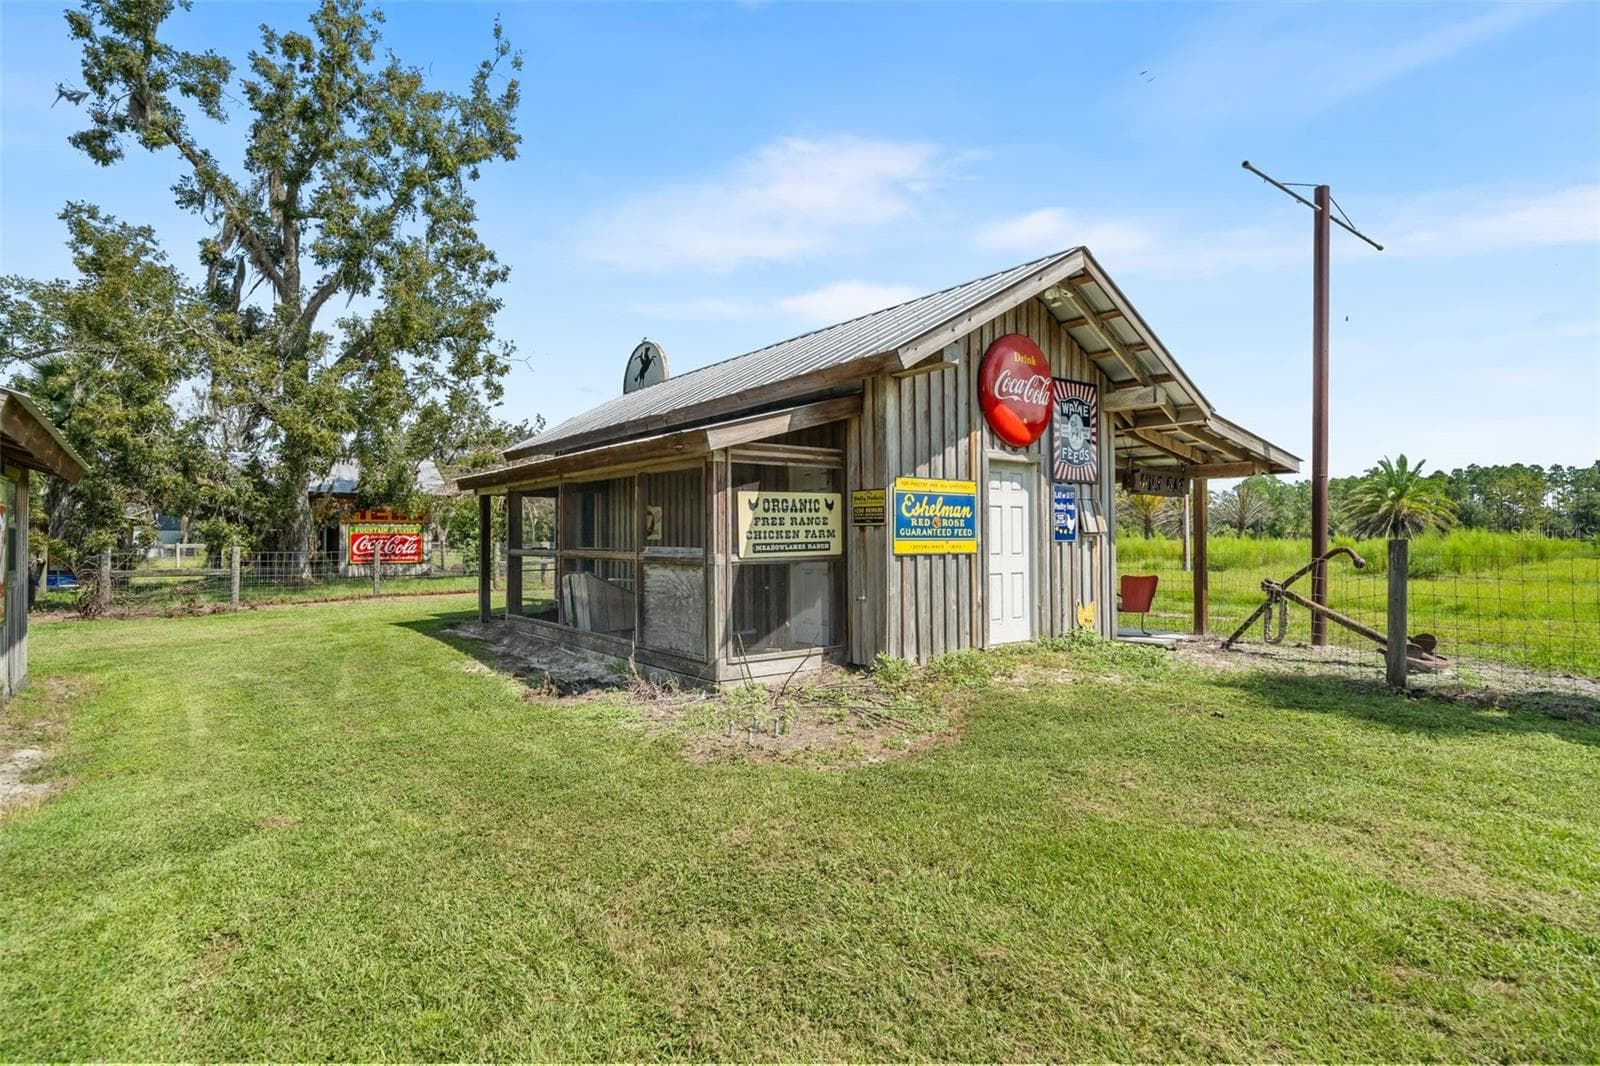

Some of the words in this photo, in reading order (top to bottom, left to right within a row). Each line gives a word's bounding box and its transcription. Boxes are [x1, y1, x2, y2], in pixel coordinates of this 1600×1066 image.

[1014, 351, 1037, 366] Drink
[1061, 400, 1090, 417] WAYNE
[1062, 446, 1090, 464] FEEDS
[762, 498, 820, 513] ORGANIC
[901, 494, 973, 518] Eshelman
[754, 516, 785, 526] FREE
[790, 516, 829, 526] RANGE
[911, 519, 930, 527] RED
[942, 519, 965, 528] ROSE
[746, 530, 800, 540] CHICKEN
[804, 529, 836, 538] FARM
[899, 528, 952, 537] GUARANTEED
[954, 528, 973, 537] FEED
